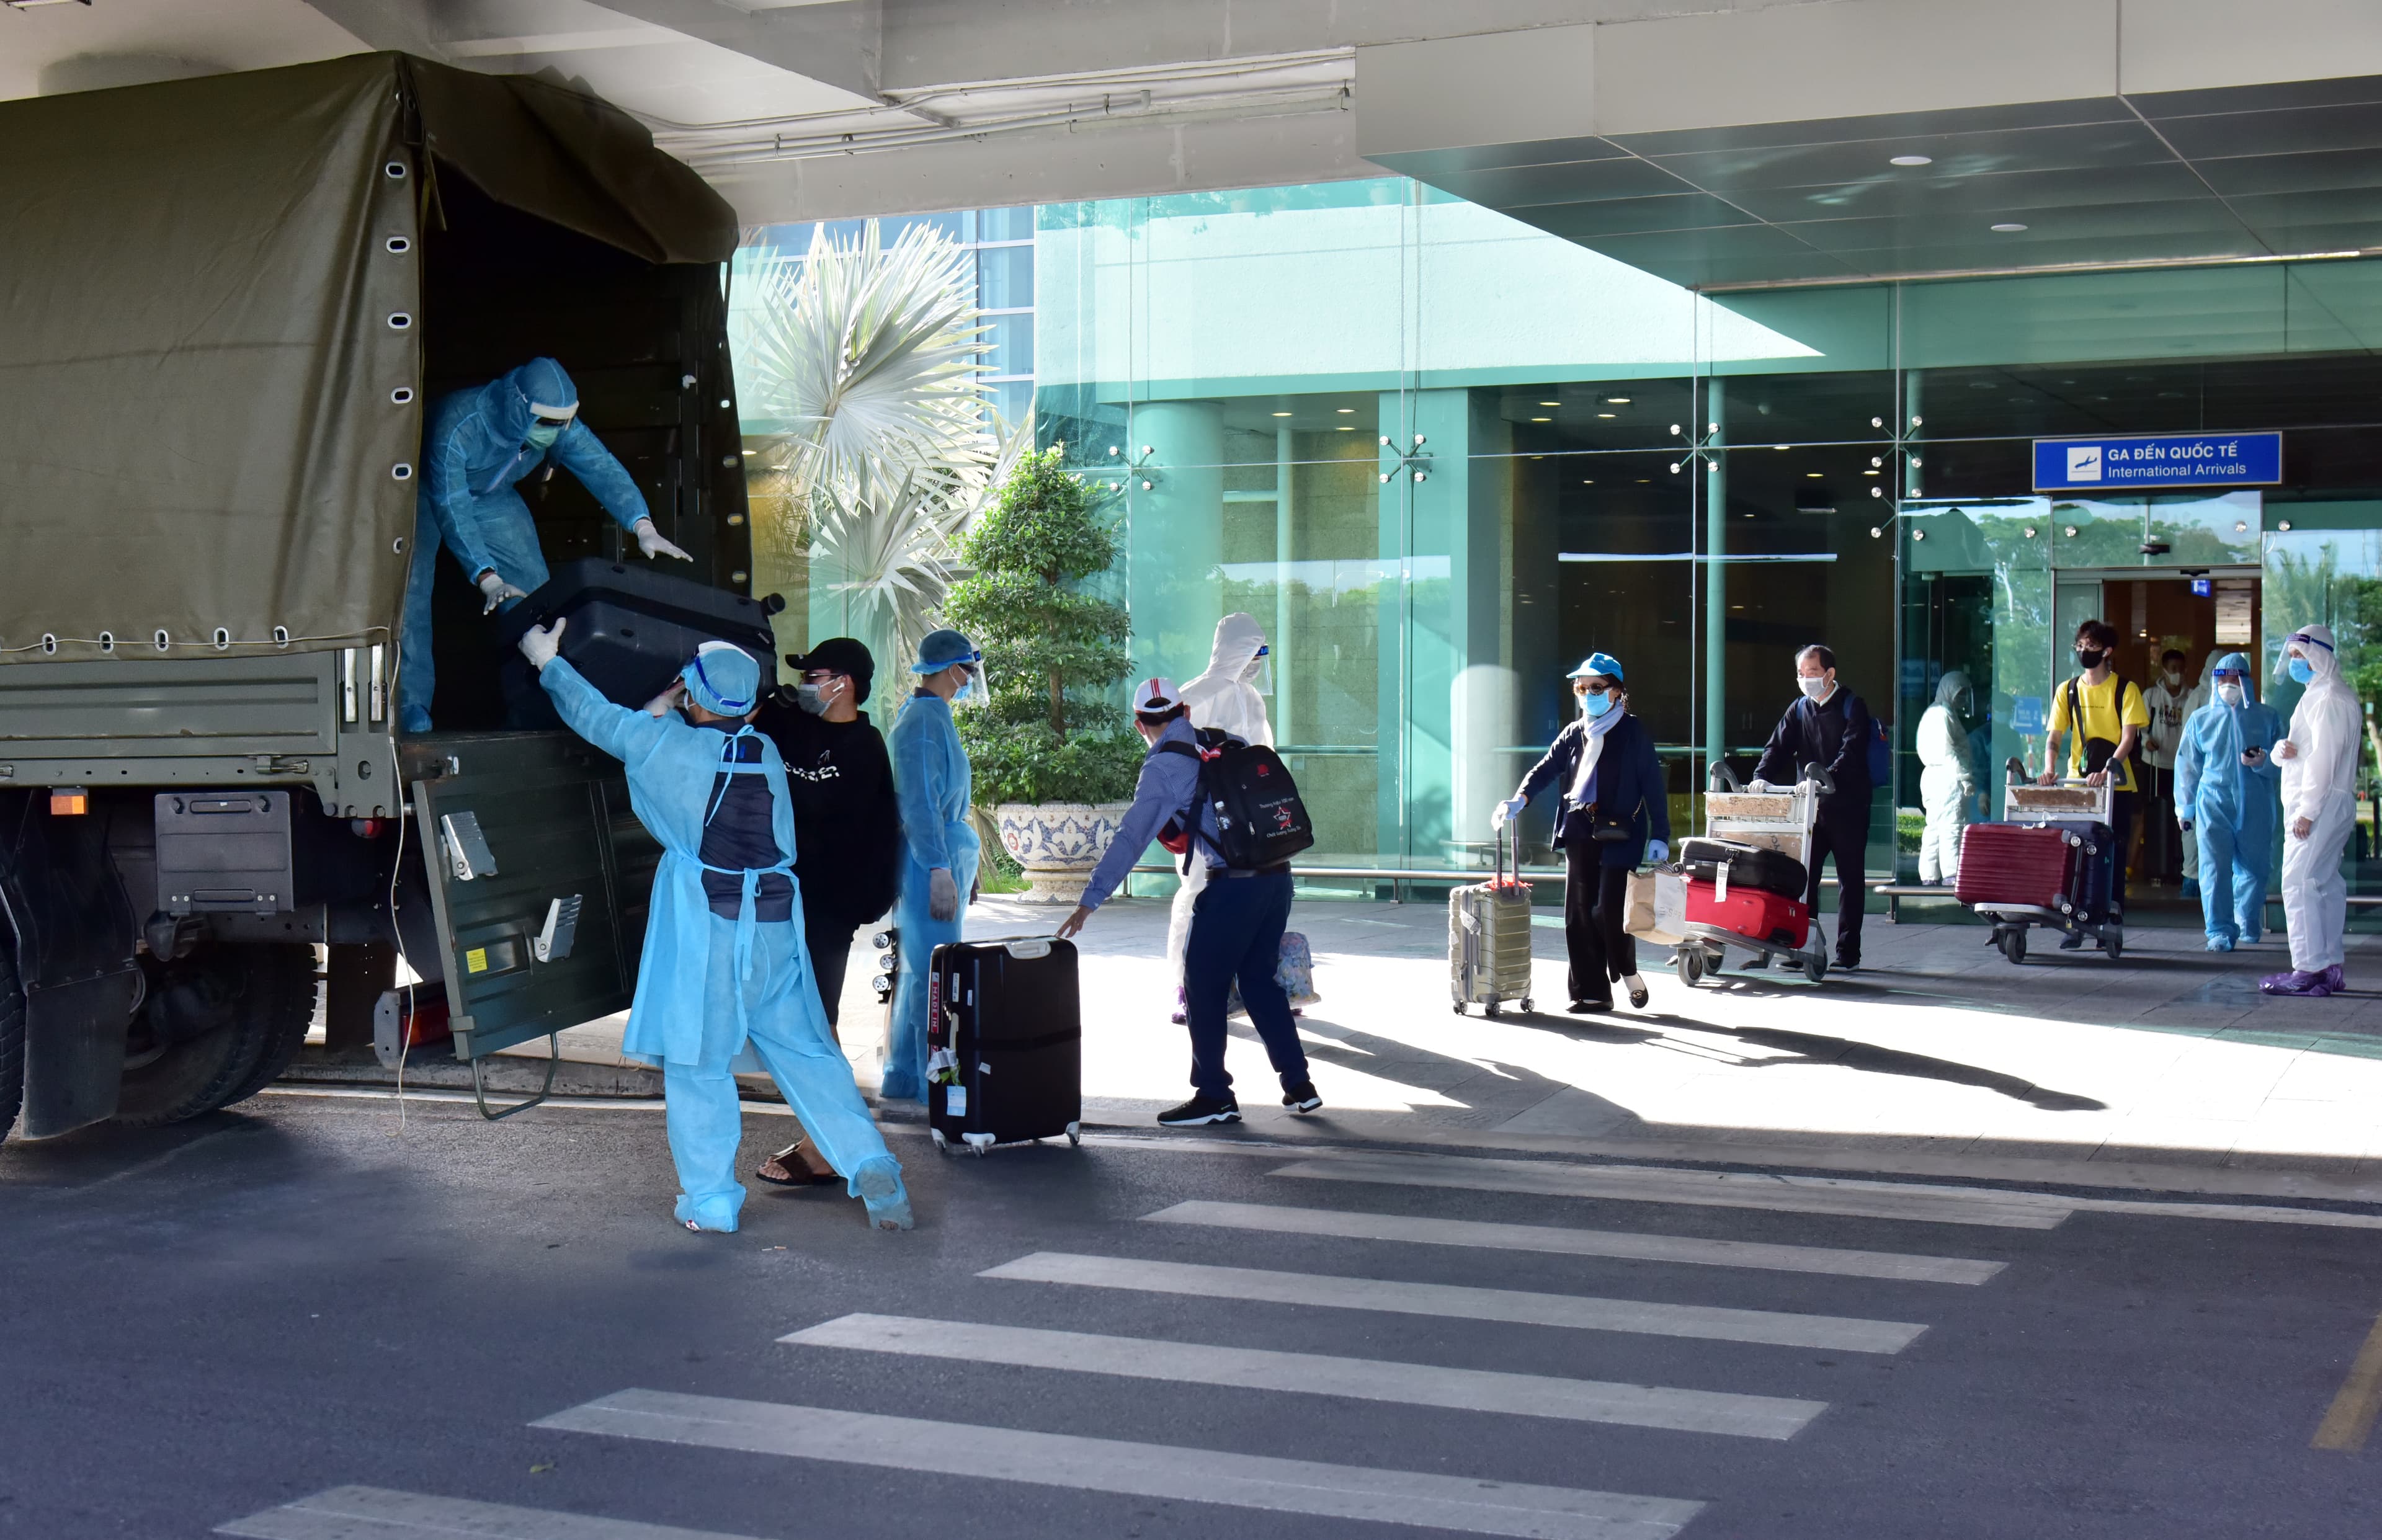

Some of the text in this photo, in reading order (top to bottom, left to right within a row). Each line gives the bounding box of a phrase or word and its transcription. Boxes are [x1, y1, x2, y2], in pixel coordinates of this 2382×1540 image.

[2108, 440, 2238, 461] GA ĐẾN QUỐC TẾ
[2108, 463, 2246, 478] International Arrivals
[932, 1017, 938, 1027] IN
